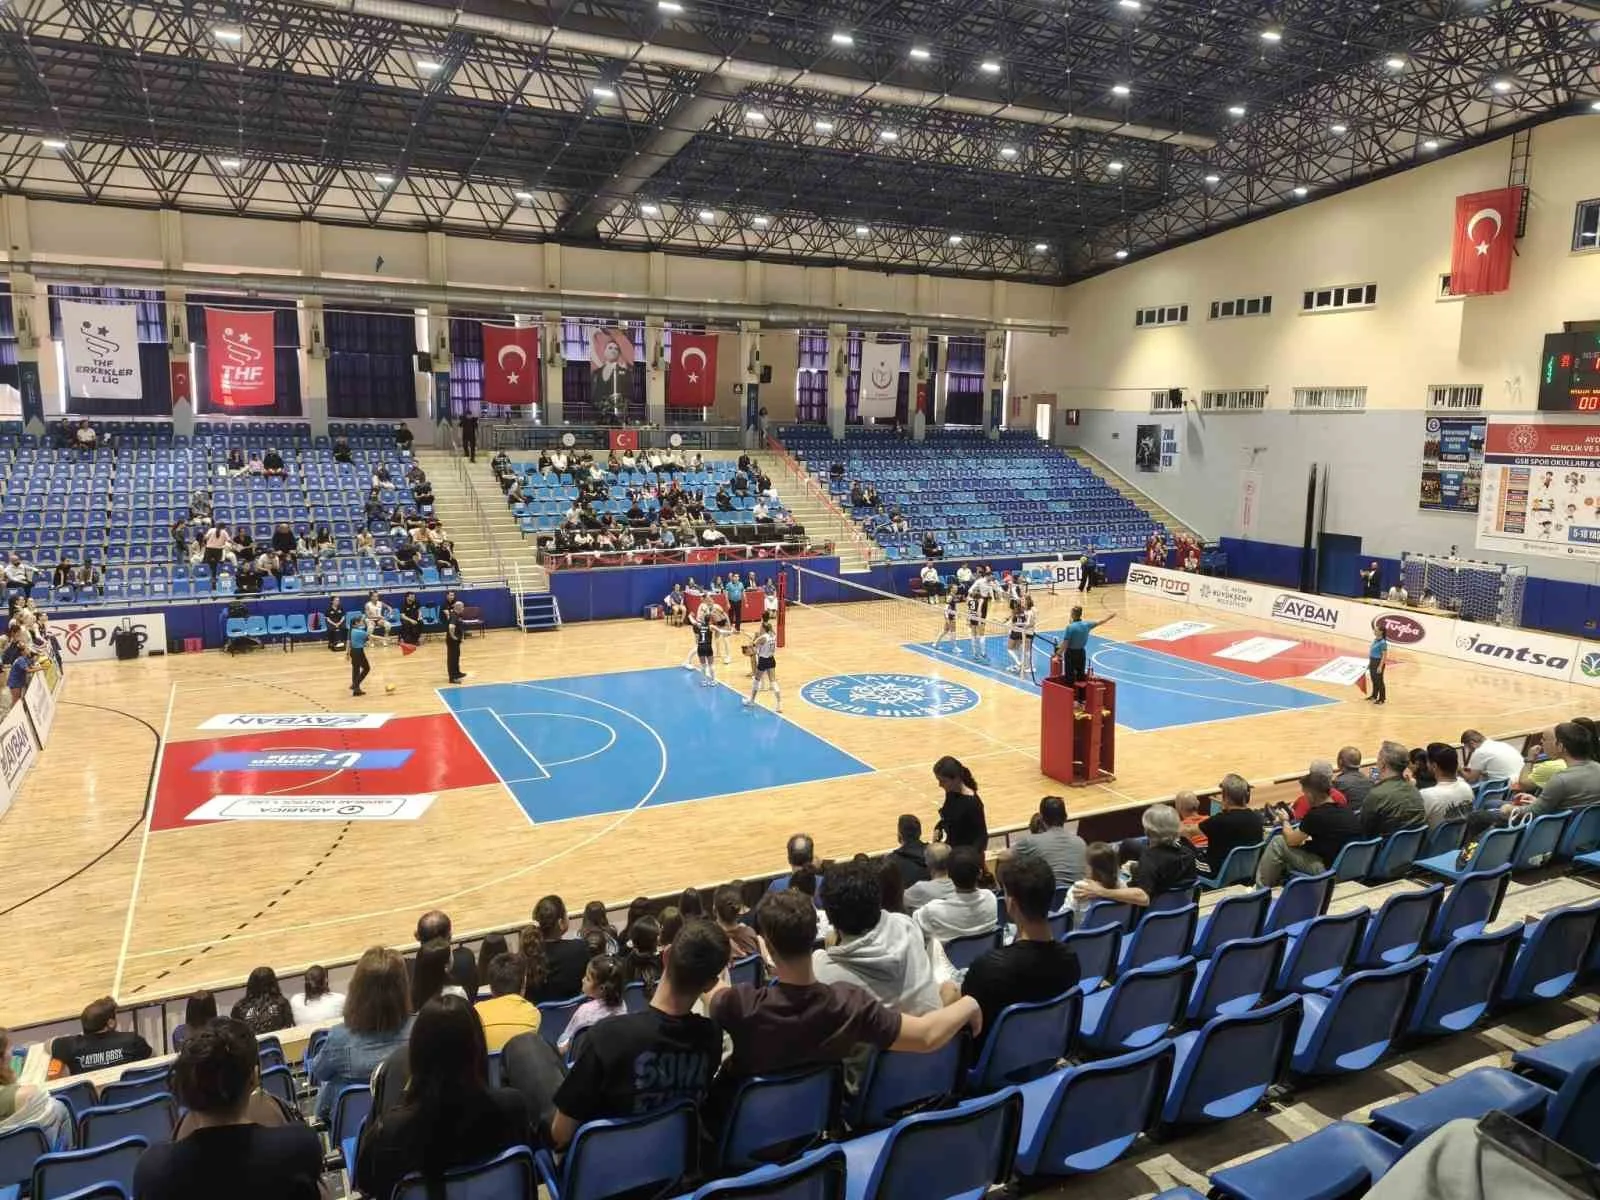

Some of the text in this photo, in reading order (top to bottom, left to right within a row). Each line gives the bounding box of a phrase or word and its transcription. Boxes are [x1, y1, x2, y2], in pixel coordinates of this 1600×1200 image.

[93, 358, 114, 368] THF
[75, 365, 133, 377] ERKEKLER
[221, 364, 264, 381] THF
[1530, 458, 1549, 466] SPOR
[1129, 570, 1190, 592] SPOR TOTO
[1284, 601, 1338, 624] AYBAN
[1465, 633, 1569, 670] jantsa
[228, 715, 332, 725] AYBAN
[85, 1051, 105, 1065] AYDIN
